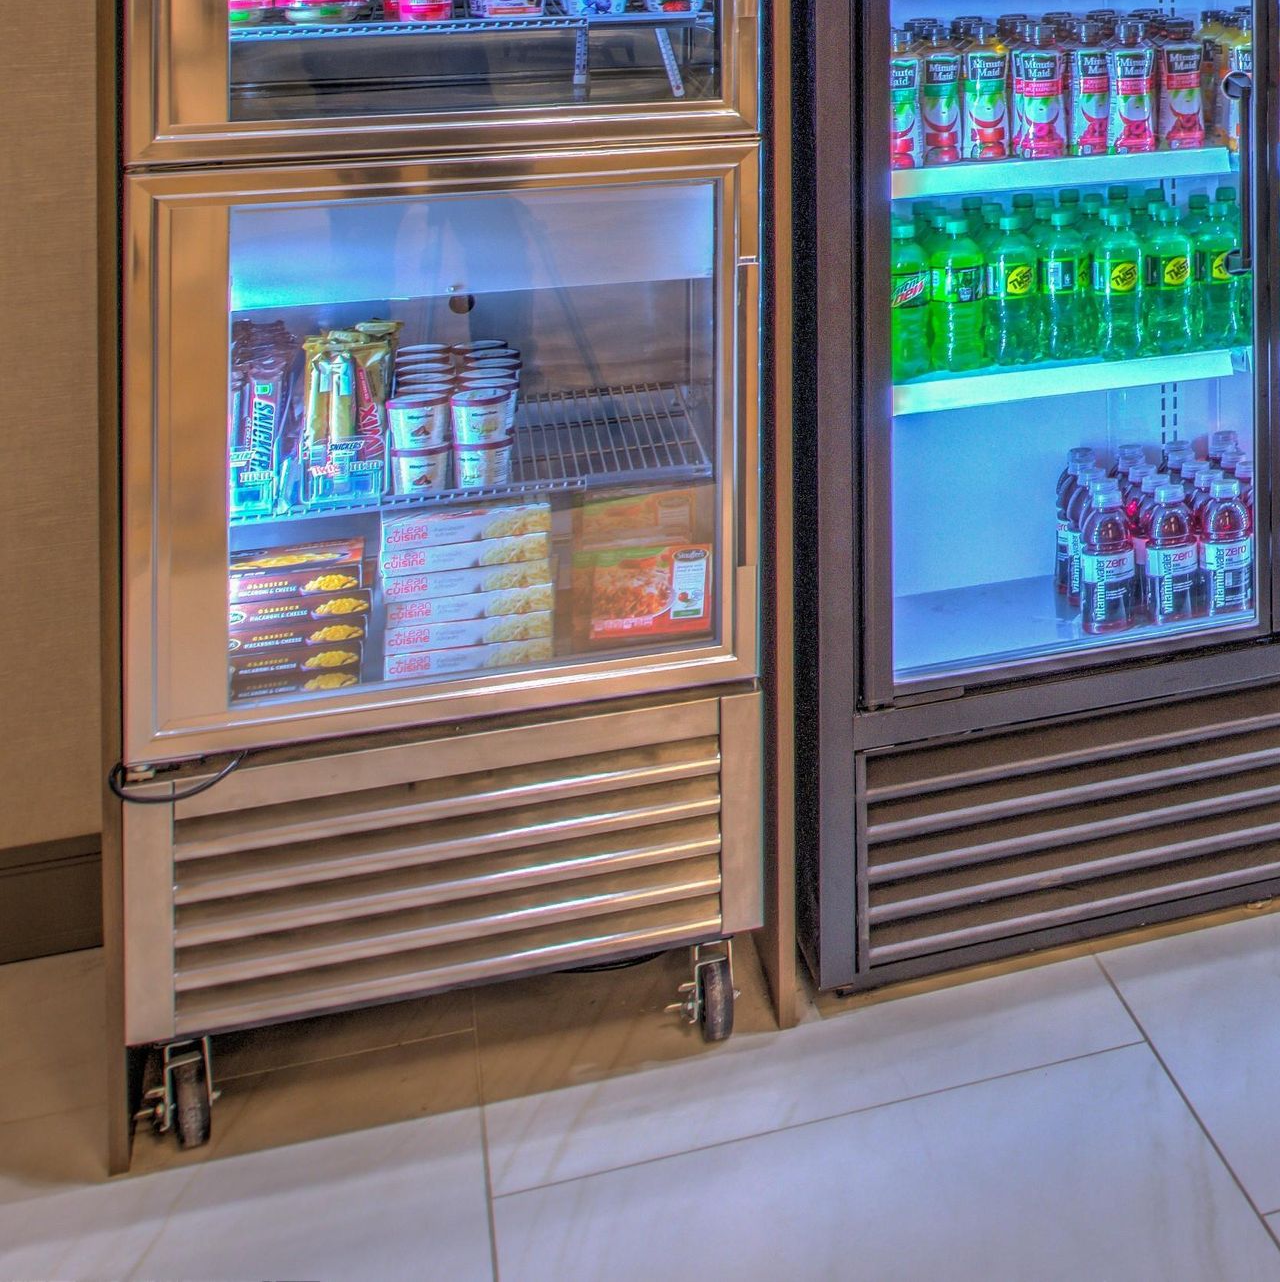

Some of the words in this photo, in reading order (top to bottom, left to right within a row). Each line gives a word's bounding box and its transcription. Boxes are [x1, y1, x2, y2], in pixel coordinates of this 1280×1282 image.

[1174, 61, 1197, 70] Maid
[933, 71, 953, 81] Maid
[978, 68, 1000, 77] Maid
[1028, 68, 1051, 78] Maid
[891, 76, 911, 86] aid
[329, 441, 364, 451] SNICKERS
[1172, 548, 1193, 561] zero
[1225, 544, 1247, 556] zero
[1106, 556, 1128, 568] zero
